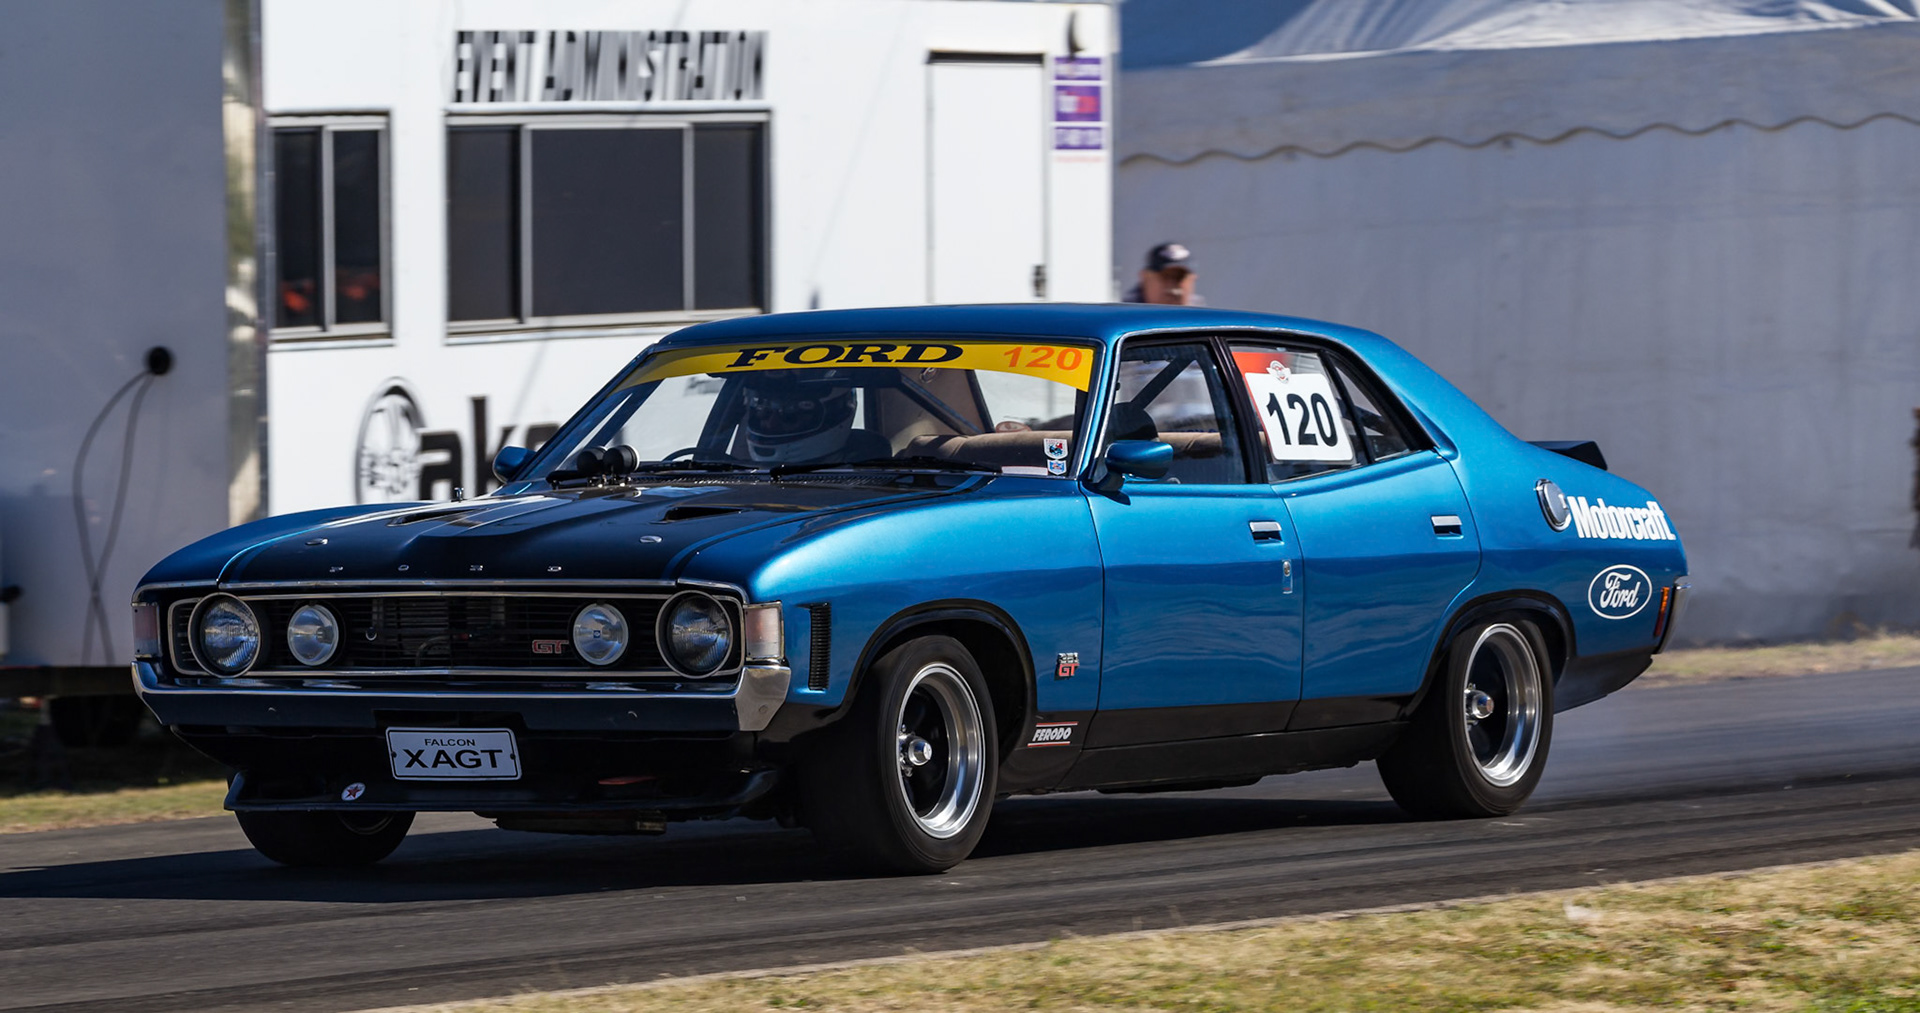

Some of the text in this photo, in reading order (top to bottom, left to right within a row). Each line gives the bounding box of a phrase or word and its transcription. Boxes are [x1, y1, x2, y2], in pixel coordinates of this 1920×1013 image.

[452, 30, 769, 102] EVENT ADMINISTRATION
[724, 343, 1084, 371] FORD 120
[1266, 392, 1338, 447] 120
[1566, 496, 1676, 540] Motorcraft
[329, 564, 563, 573] FORD
[1599, 571, 1642, 609] Ford
[531, 639, 570, 655] GT
[1058, 663, 1080, 677] GT
[424, 738, 476, 747] FALCON
[1032, 727, 1072, 742] FERODO
[402, 748, 503, 769] XAGT
